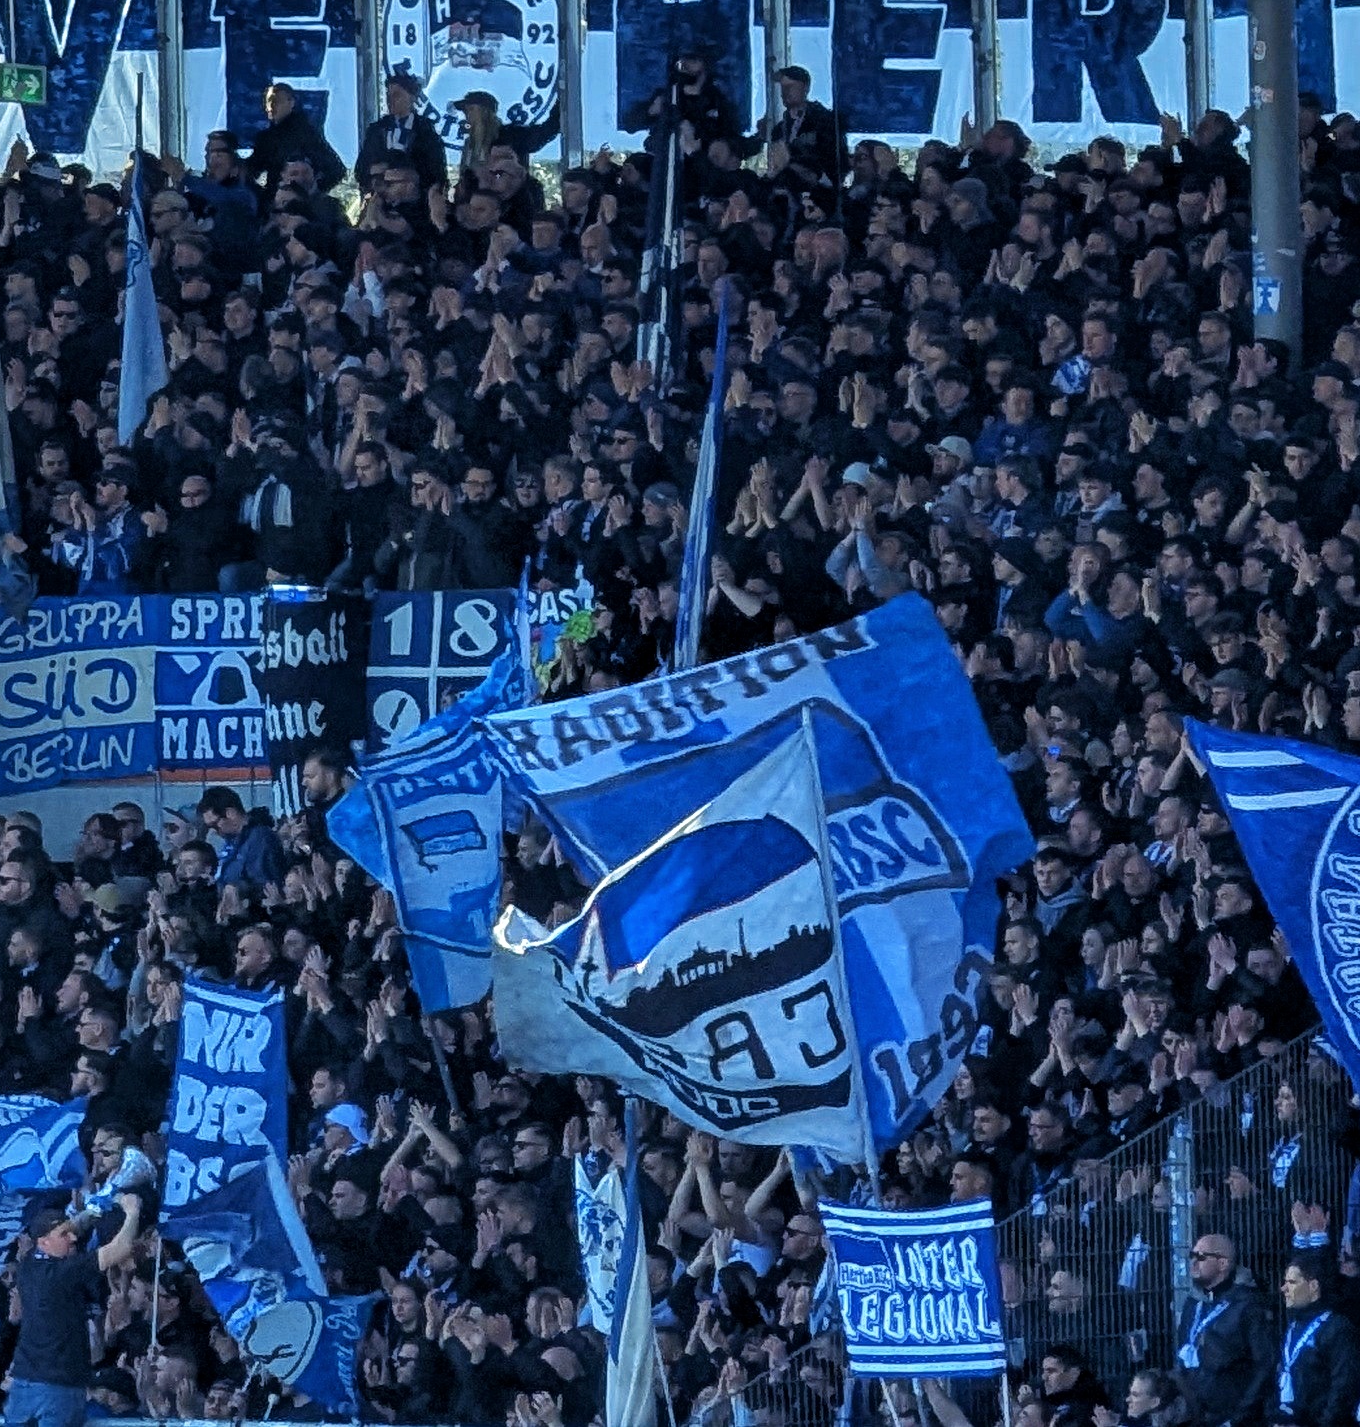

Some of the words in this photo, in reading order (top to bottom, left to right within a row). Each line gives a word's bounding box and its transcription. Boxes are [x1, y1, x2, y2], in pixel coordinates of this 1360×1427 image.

[392, 23, 417, 46] 18
[527, 23, 556, 45] 92
[0, 727, 136, 783] BERLIN
[173, 1074, 268, 1147] DER
[163, 1148, 261, 1207] BS
[892, 1235, 985, 1291] INTER
